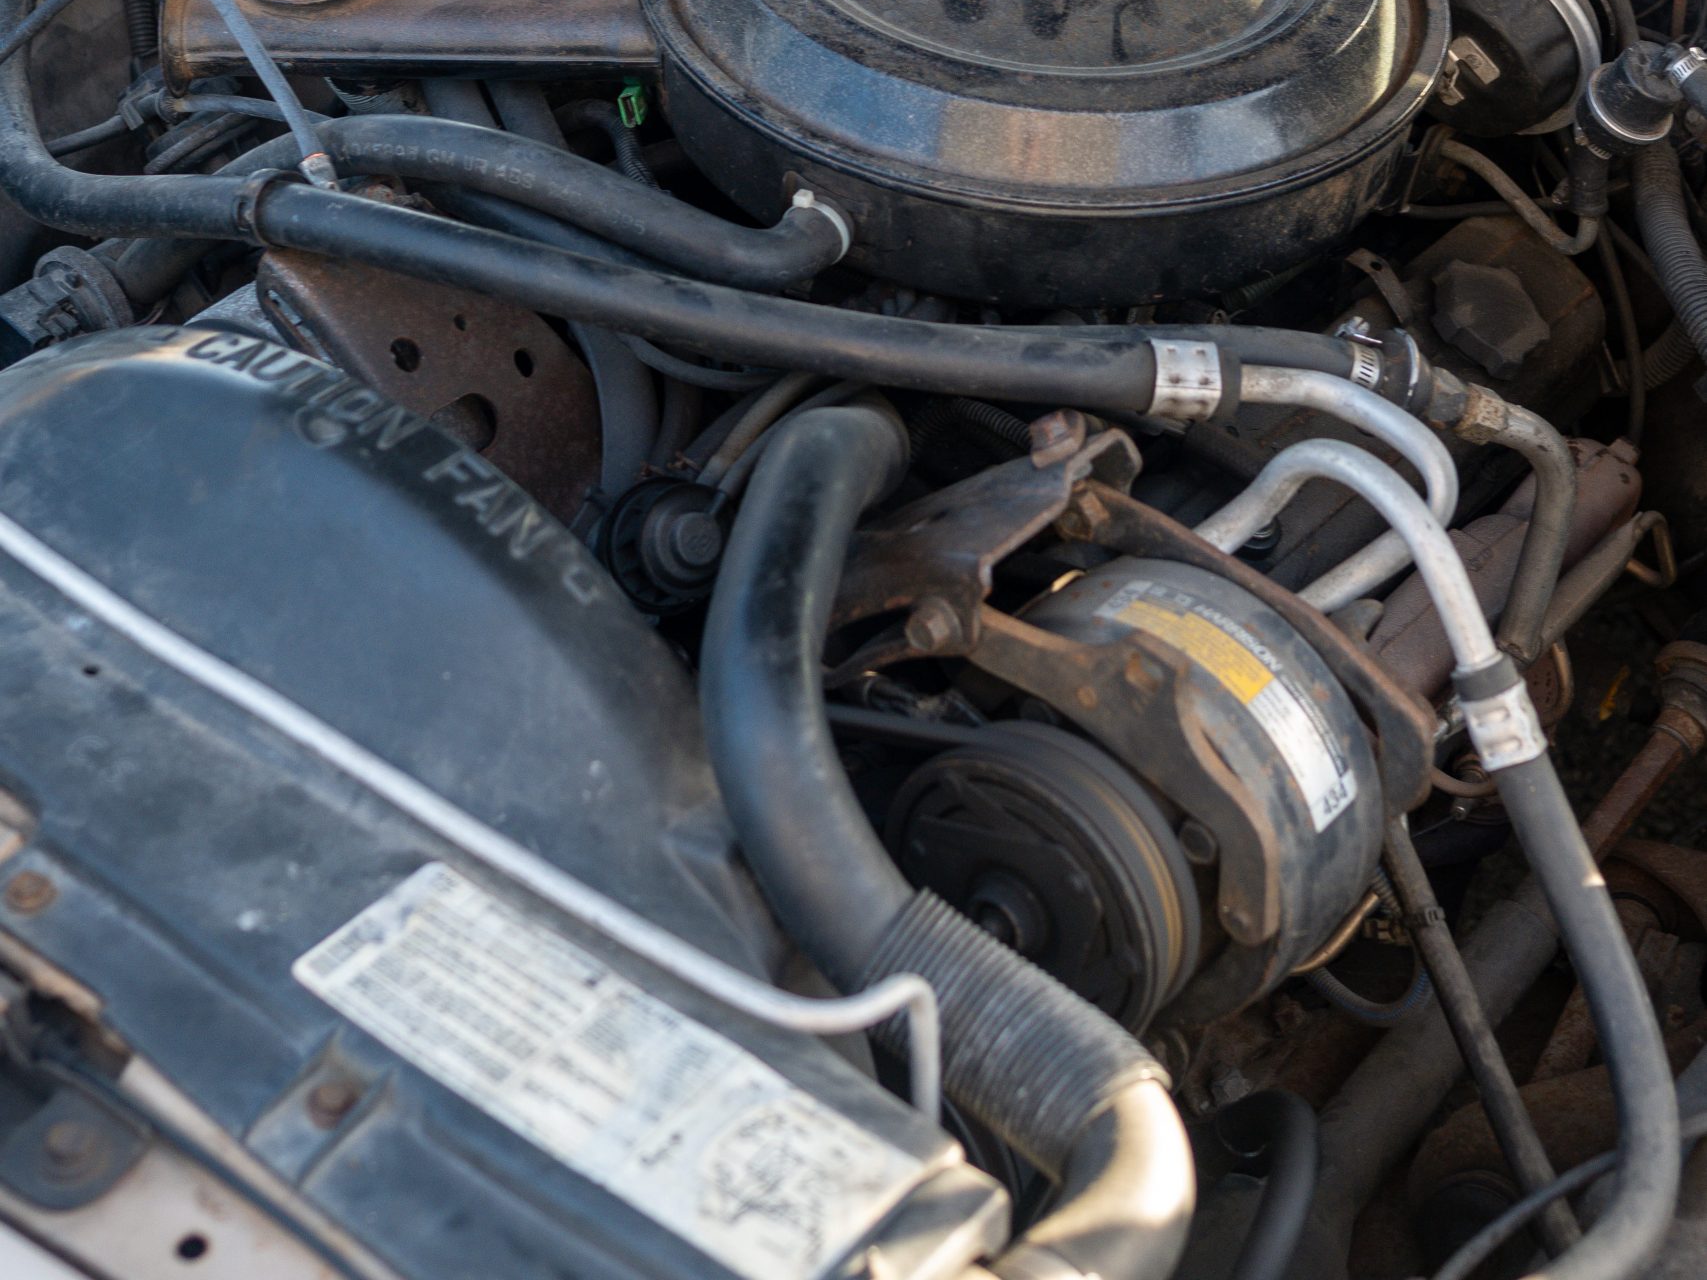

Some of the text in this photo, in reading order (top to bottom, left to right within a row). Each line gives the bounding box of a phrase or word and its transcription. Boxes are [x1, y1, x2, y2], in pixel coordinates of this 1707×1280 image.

[185, 334, 421, 451] CAUTION
[422, 449, 561, 561] FAN
[1193, 605, 1283, 672] HARRISON
[1321, 782, 1348, 816] 434
